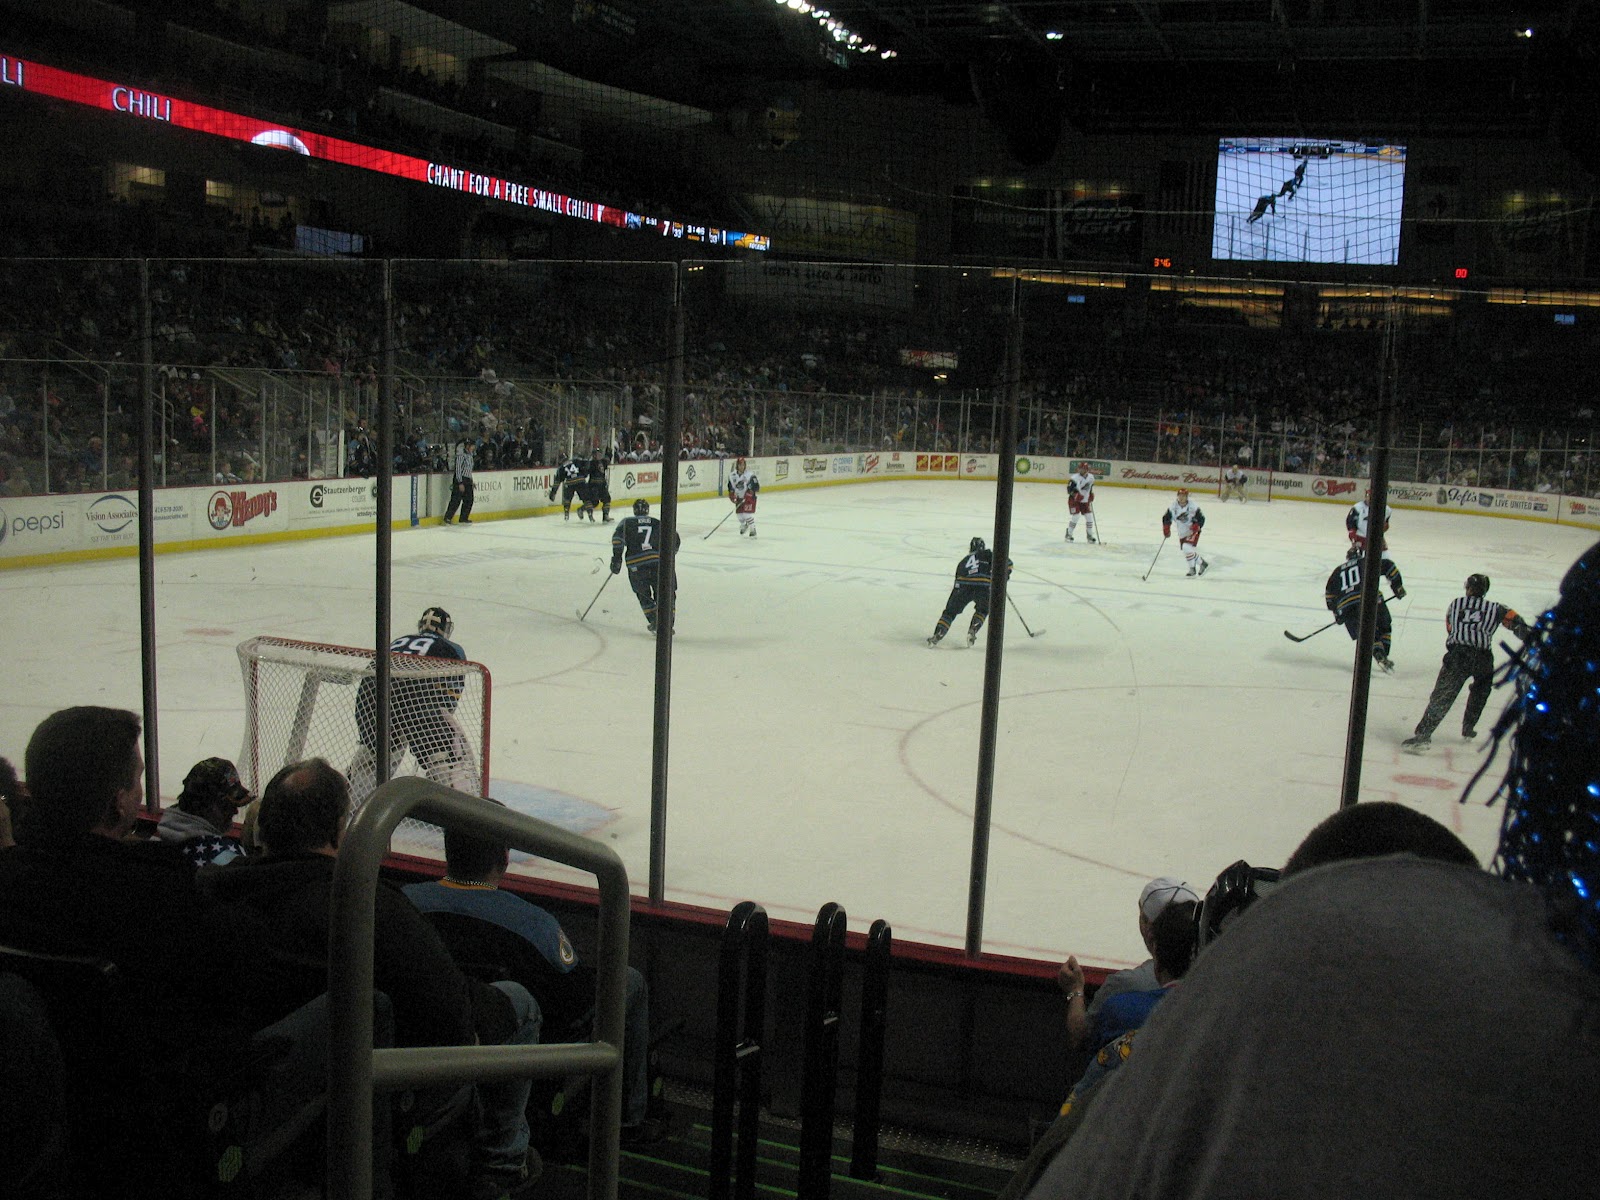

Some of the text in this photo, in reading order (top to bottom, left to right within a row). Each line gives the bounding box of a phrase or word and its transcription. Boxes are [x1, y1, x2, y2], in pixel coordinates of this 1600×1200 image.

[111, 86, 172, 122] CHILI
[427, 163, 594, 220] CHANT FOR A FREE SMALL CHILI!
[662, 220, 670, 237] 7
[687, 225, 706, 236] 3:46
[1032, 461, 1045, 472] bp
[1121, 468, 1180, 482] Budweiser
[1183, 472, 1222, 484] Budwe
[323, 486, 366, 495] Stautzenberger
[473, 481, 502, 492] MEDICA
[513, 477, 544, 491] THERMA
[231, 490, 278, 527] Wendy's
[1495, 499, 1508, 507] LIVE
[1510, 501, 1532, 510] UNITED
[85, 510, 138, 521] Vision Associates
[12, 511, 64, 536] pepsi
[637, 526, 652, 550] 7
[965, 554, 979, 569] 4
[1340, 565, 1361, 591] 10
[1462, 609, 1481, 622] 14
